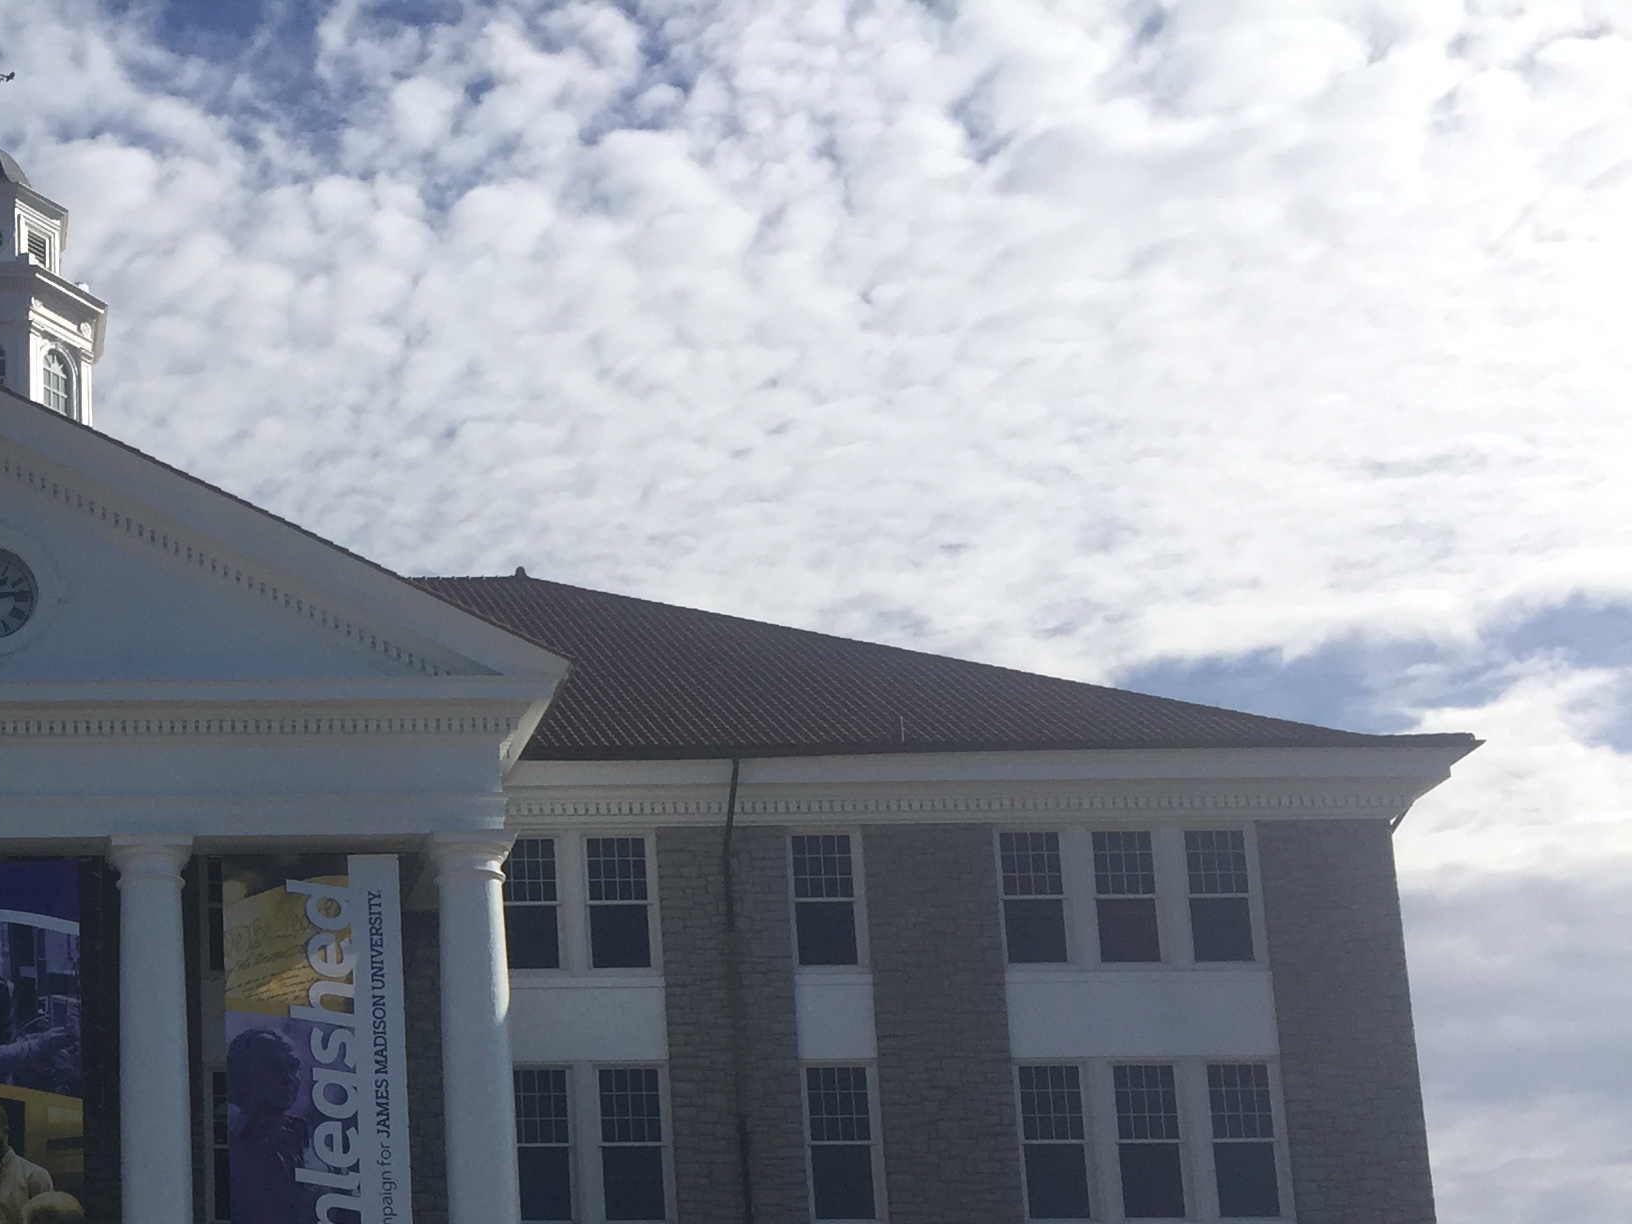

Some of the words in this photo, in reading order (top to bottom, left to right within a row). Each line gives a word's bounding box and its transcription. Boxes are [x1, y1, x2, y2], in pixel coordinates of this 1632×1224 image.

[368, 890, 385, 991] UNIVERSITY
[372, 995, 388, 1075] MADISON
[375, 1079, 390, 1138] JAMES
[377, 1141, 392, 1166] for
